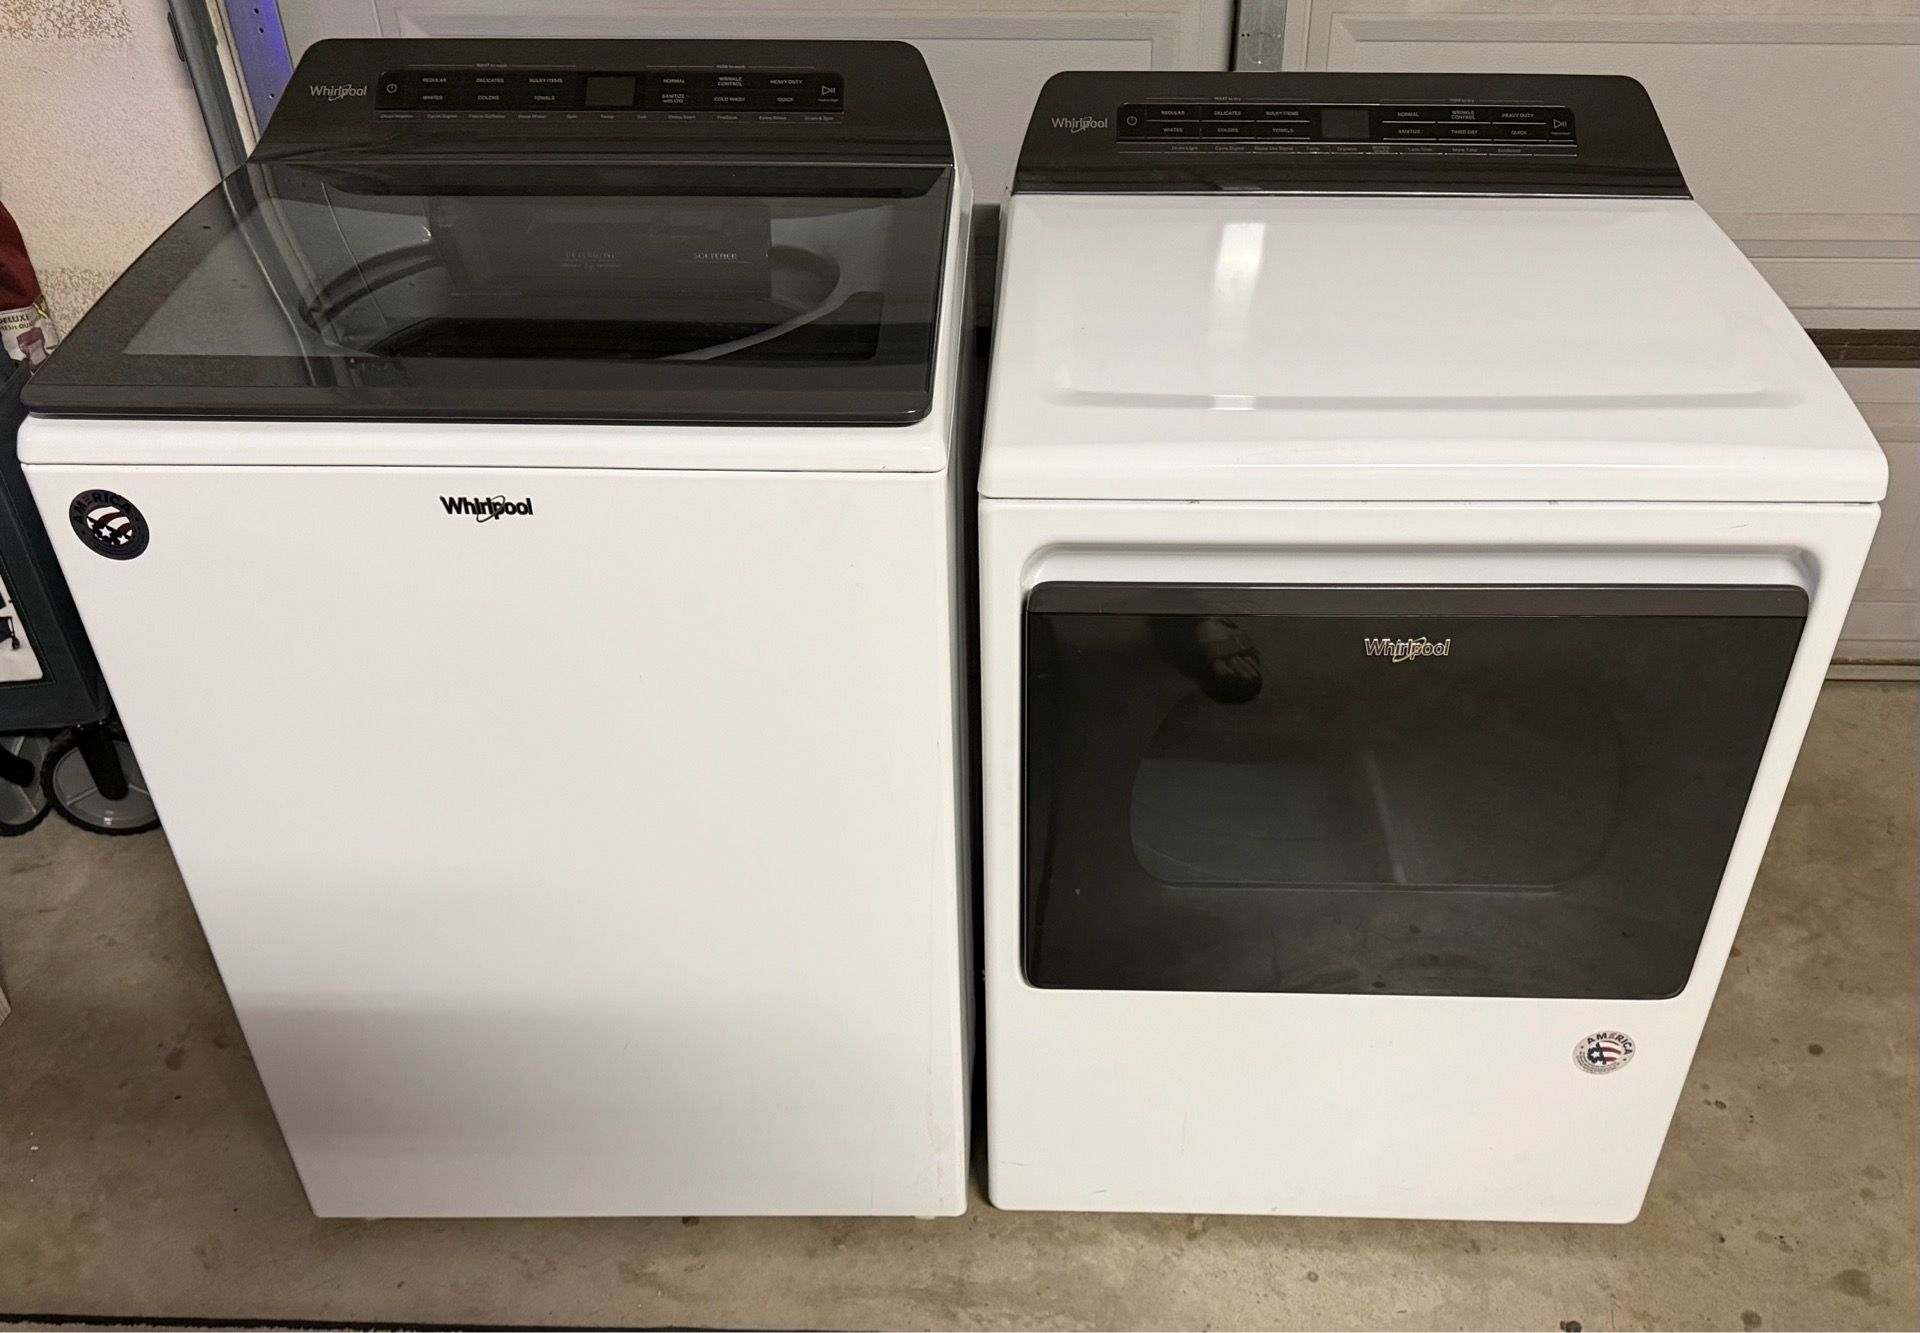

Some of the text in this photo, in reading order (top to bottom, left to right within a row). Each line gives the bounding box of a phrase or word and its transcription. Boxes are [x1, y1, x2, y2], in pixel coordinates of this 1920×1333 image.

[310, 83, 368, 102] Whirlpool
[1051, 115, 1109, 133] Whirlpool
[73, 492, 131, 525] AMERICA
[439, 495, 534, 524] Whirlpool
[1364, 636, 1451, 663] Whirlpool
[1586, 1032, 1633, 1055] AMERICA
